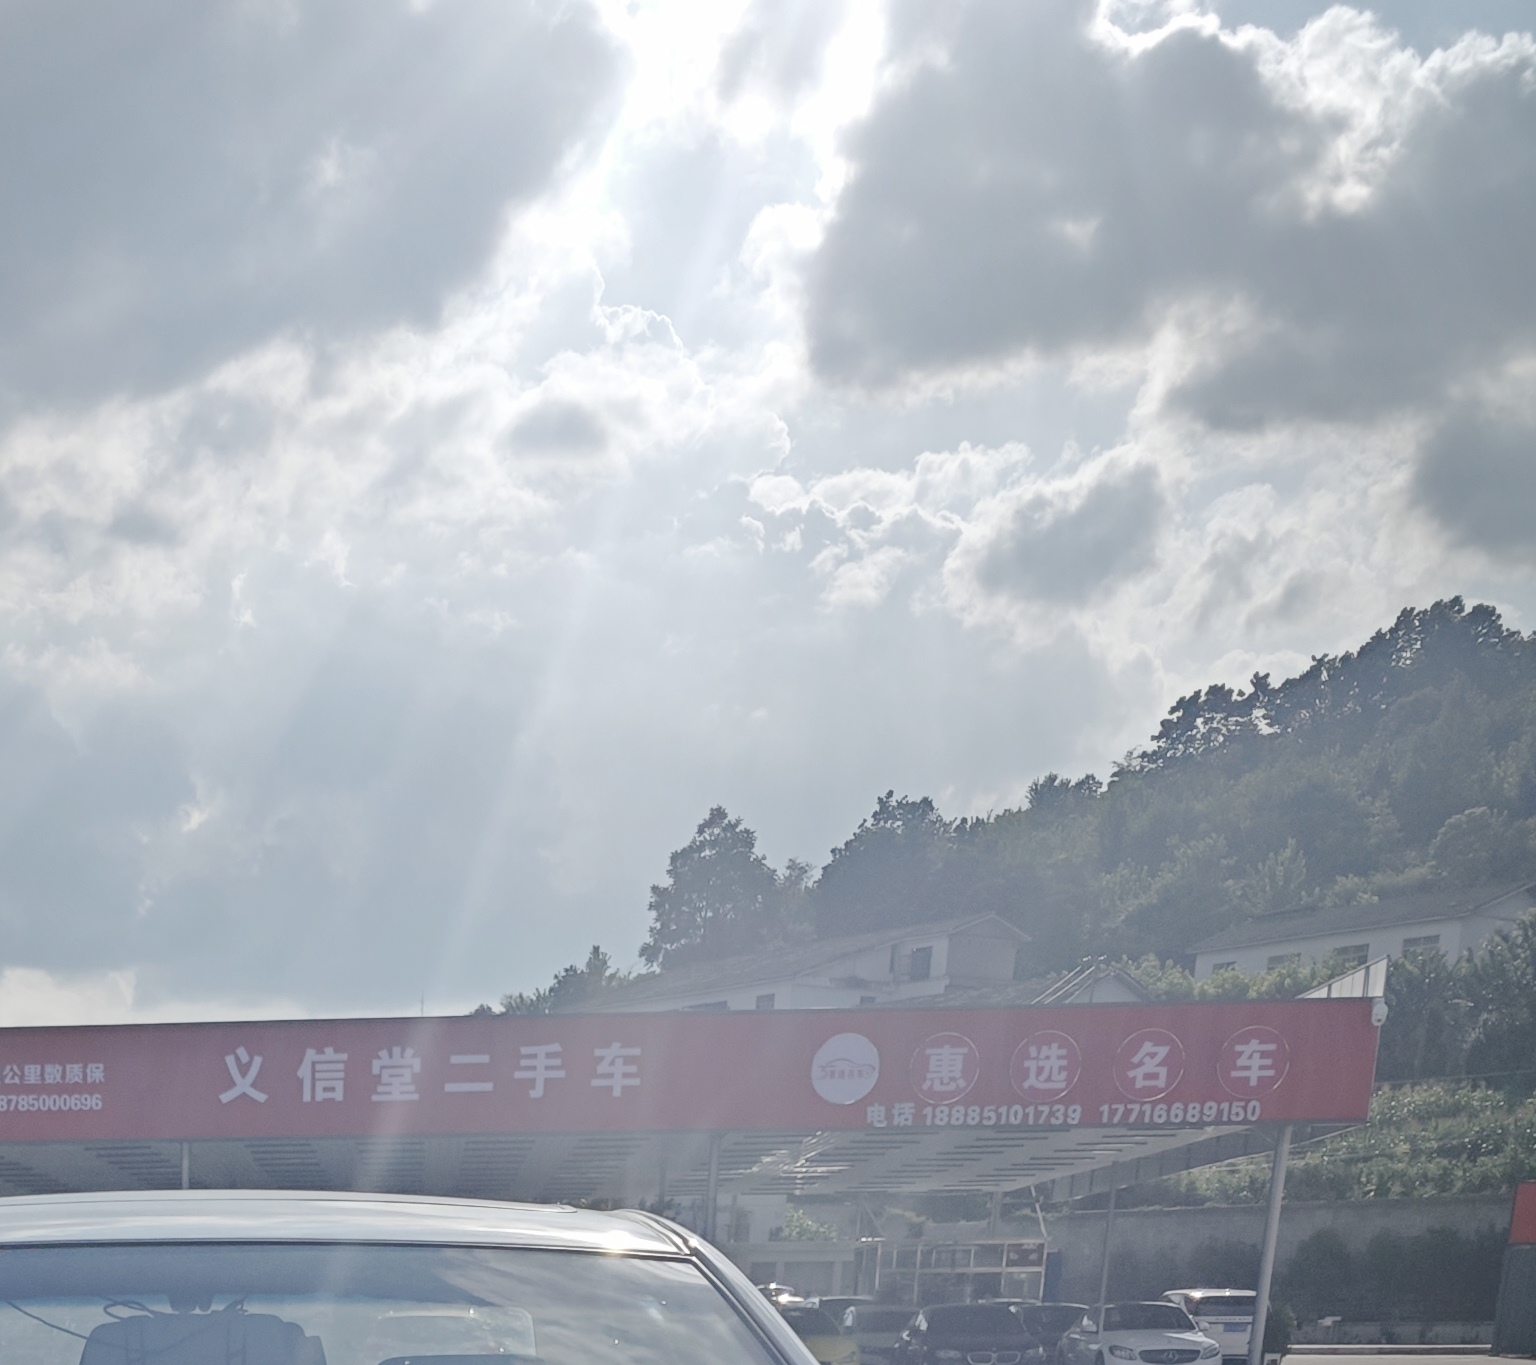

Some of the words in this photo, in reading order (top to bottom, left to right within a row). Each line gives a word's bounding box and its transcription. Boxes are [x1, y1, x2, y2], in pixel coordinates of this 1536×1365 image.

[218, 1042, 642, 1104] 义信堂二手车
[921, 1038, 1278, 1092] 惠选名车
[866, 1102, 916, 1128] 电话
[922, 1103, 1083, 1127] 18885101739
[1099, 1100, 1262, 1123] 17716689150
